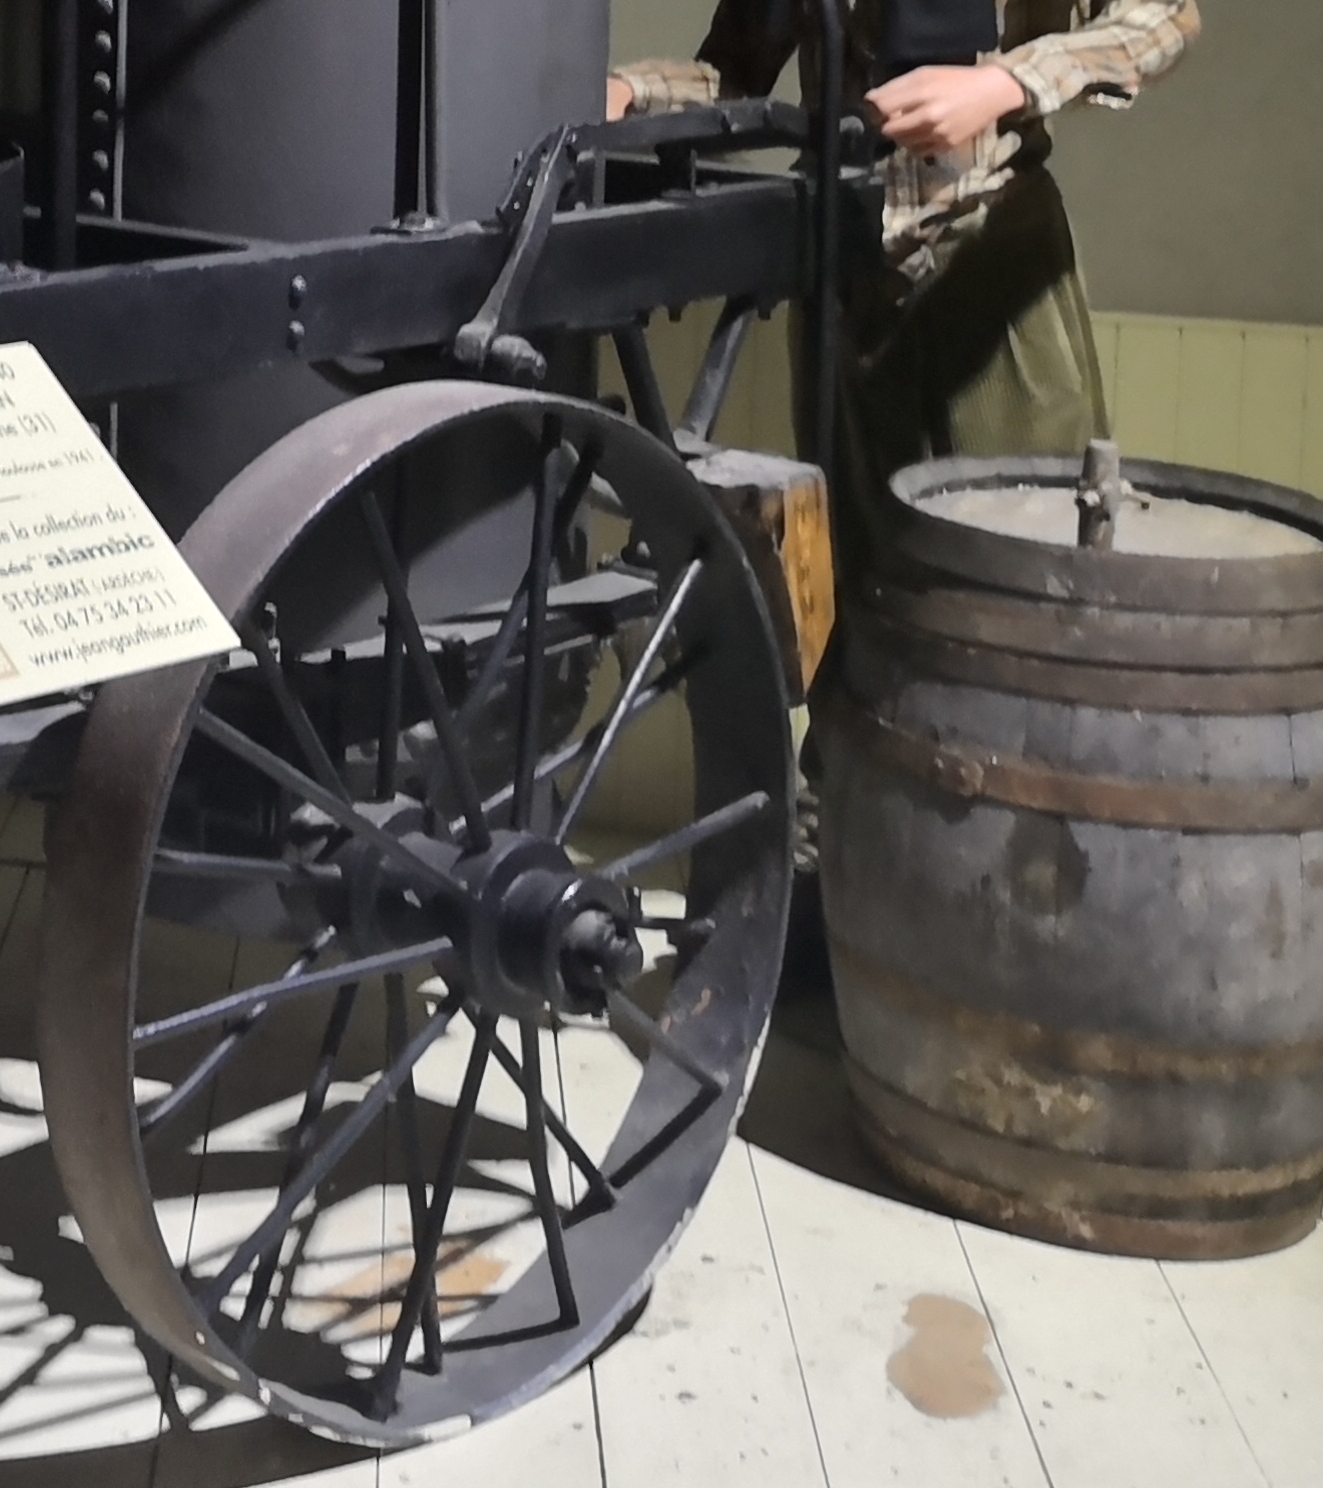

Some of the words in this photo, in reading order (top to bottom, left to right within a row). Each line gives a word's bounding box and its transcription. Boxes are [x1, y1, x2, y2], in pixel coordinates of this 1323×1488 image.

[17, 412, 56, 437] (31)
[9, 520, 29, 541] la
[33, 510, 103, 538] collection
[106, 503, 126, 523] du
[45, 533, 154, 568] alambic
[53, 610, 79, 631] 04
[78, 604, 103, 625] 75
[104, 599, 129, 620] 34
[128, 594, 153, 615] 23
[153, 588, 177, 609] 11
[29, 616, 207, 667] www.jeangauthier.com
